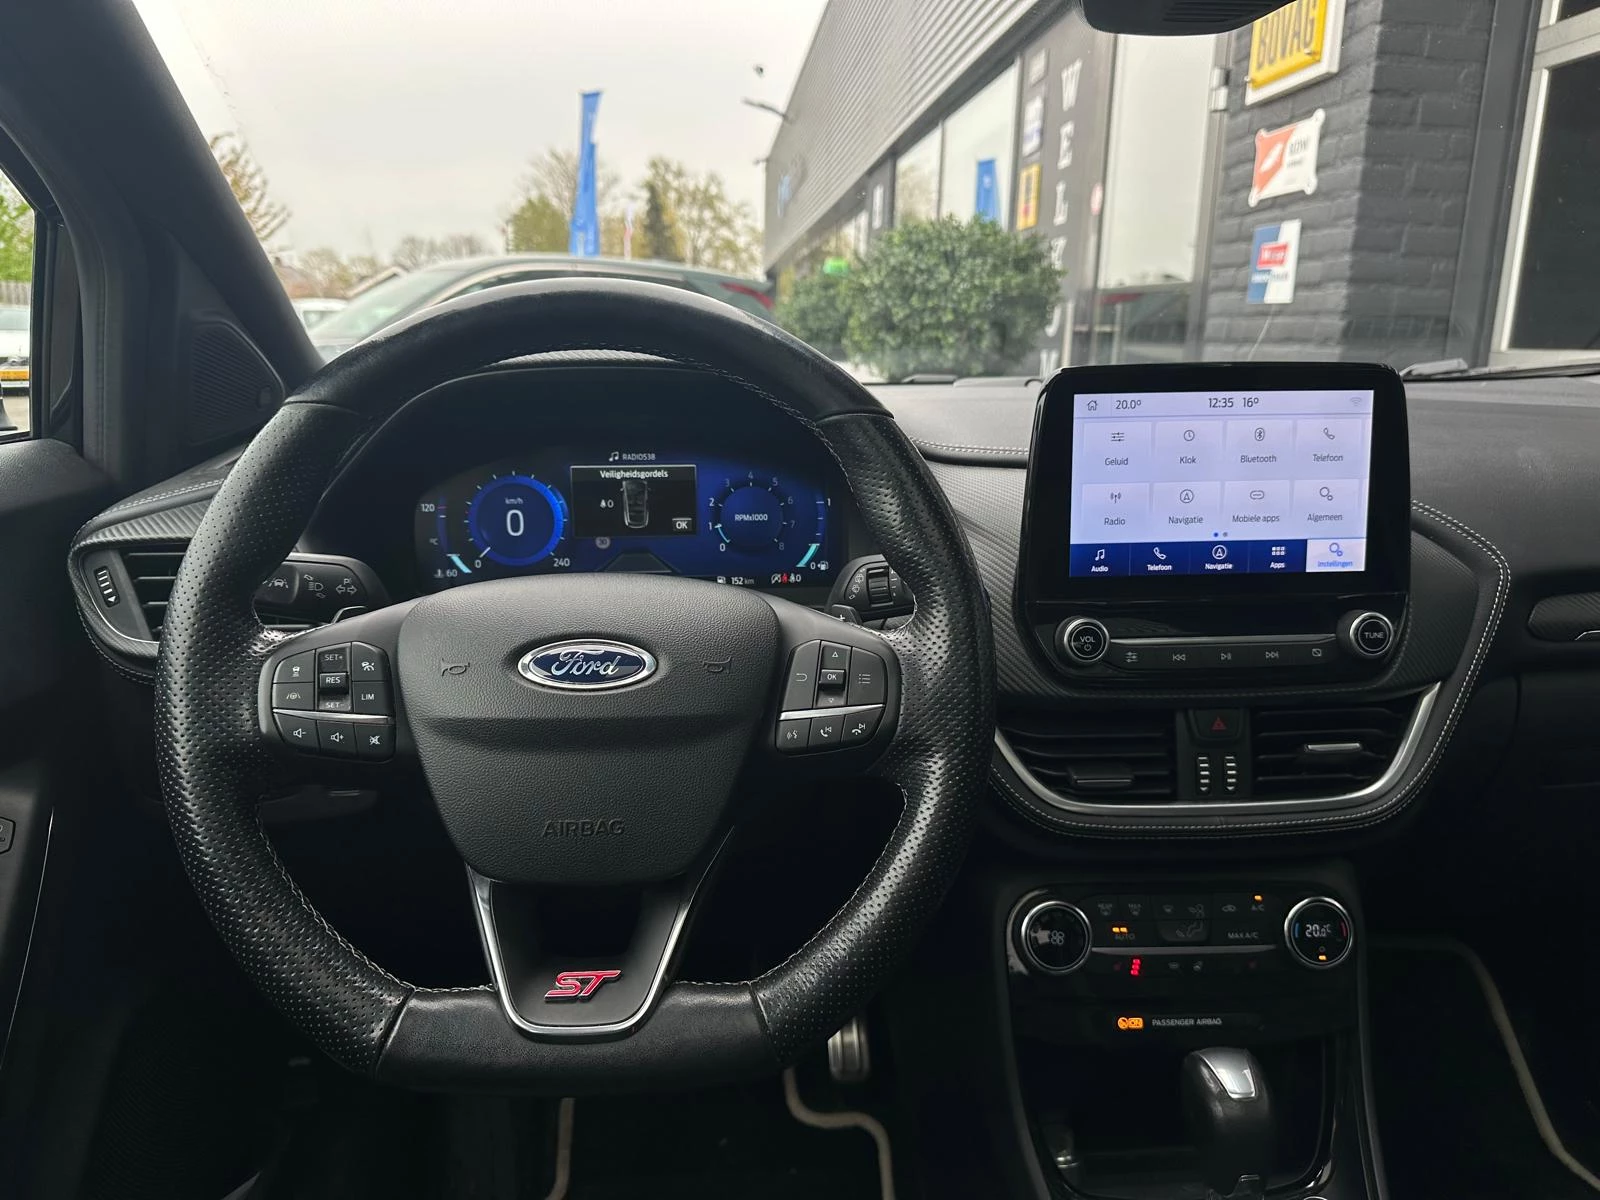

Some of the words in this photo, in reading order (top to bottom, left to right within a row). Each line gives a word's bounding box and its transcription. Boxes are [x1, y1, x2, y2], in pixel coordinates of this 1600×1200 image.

[1208, 397, 1234, 408] 12:35
[622, 453, 656, 461] RADIO538
[1104, 457, 1129, 466] Geluid
[1179, 456, 1197, 465] Klok
[1240, 454, 1277, 464] Bluetooth
[1313, 453, 1343, 463] Telefoon
[600, 469, 668, 480] Veiligheidsgordels
[709, 497, 715, 507] 2
[421, 503, 435, 512] 120
[1104, 517, 1126, 526] Radio
[1168, 515, 1203, 526] Navigatie
[1232, 514, 1261, 523] Mobiele
[1262, 514, 1280, 523] apps
[1307, 513, 1343, 522] Algemeen
[506, 509, 524, 536] 0
[675, 521, 688, 530] OK
[719, 543, 726, 552] 0
[475, 560, 482, 569] 0
[553, 558, 571, 568] 240
[810, 562, 816, 570] 0
[1205, 562, 1233, 571] Navigatie
[1270, 561, 1285, 569] Apps
[1317, 559, 1353, 569] Instellingen
[1091, 565, 1109, 573] Audio
[1147, 564, 1172, 572] Telefoon
[446, 569, 458, 578] 60
[731, 576, 743, 585] 152
[1079, 635, 1096, 643] VOL
[1364, 631, 1385, 639] TUNE
[550, 649, 622, 676] Ford
[325, 675, 341, 684] RES
[361, 693, 374, 701] LIM
[542, 818, 626, 838] AIRBAG
[545, 969, 621, 998] ST
[1151, 1018, 1195, 1026] PASSENGER
[1196, 1017, 1222, 1025] AIRBAG
